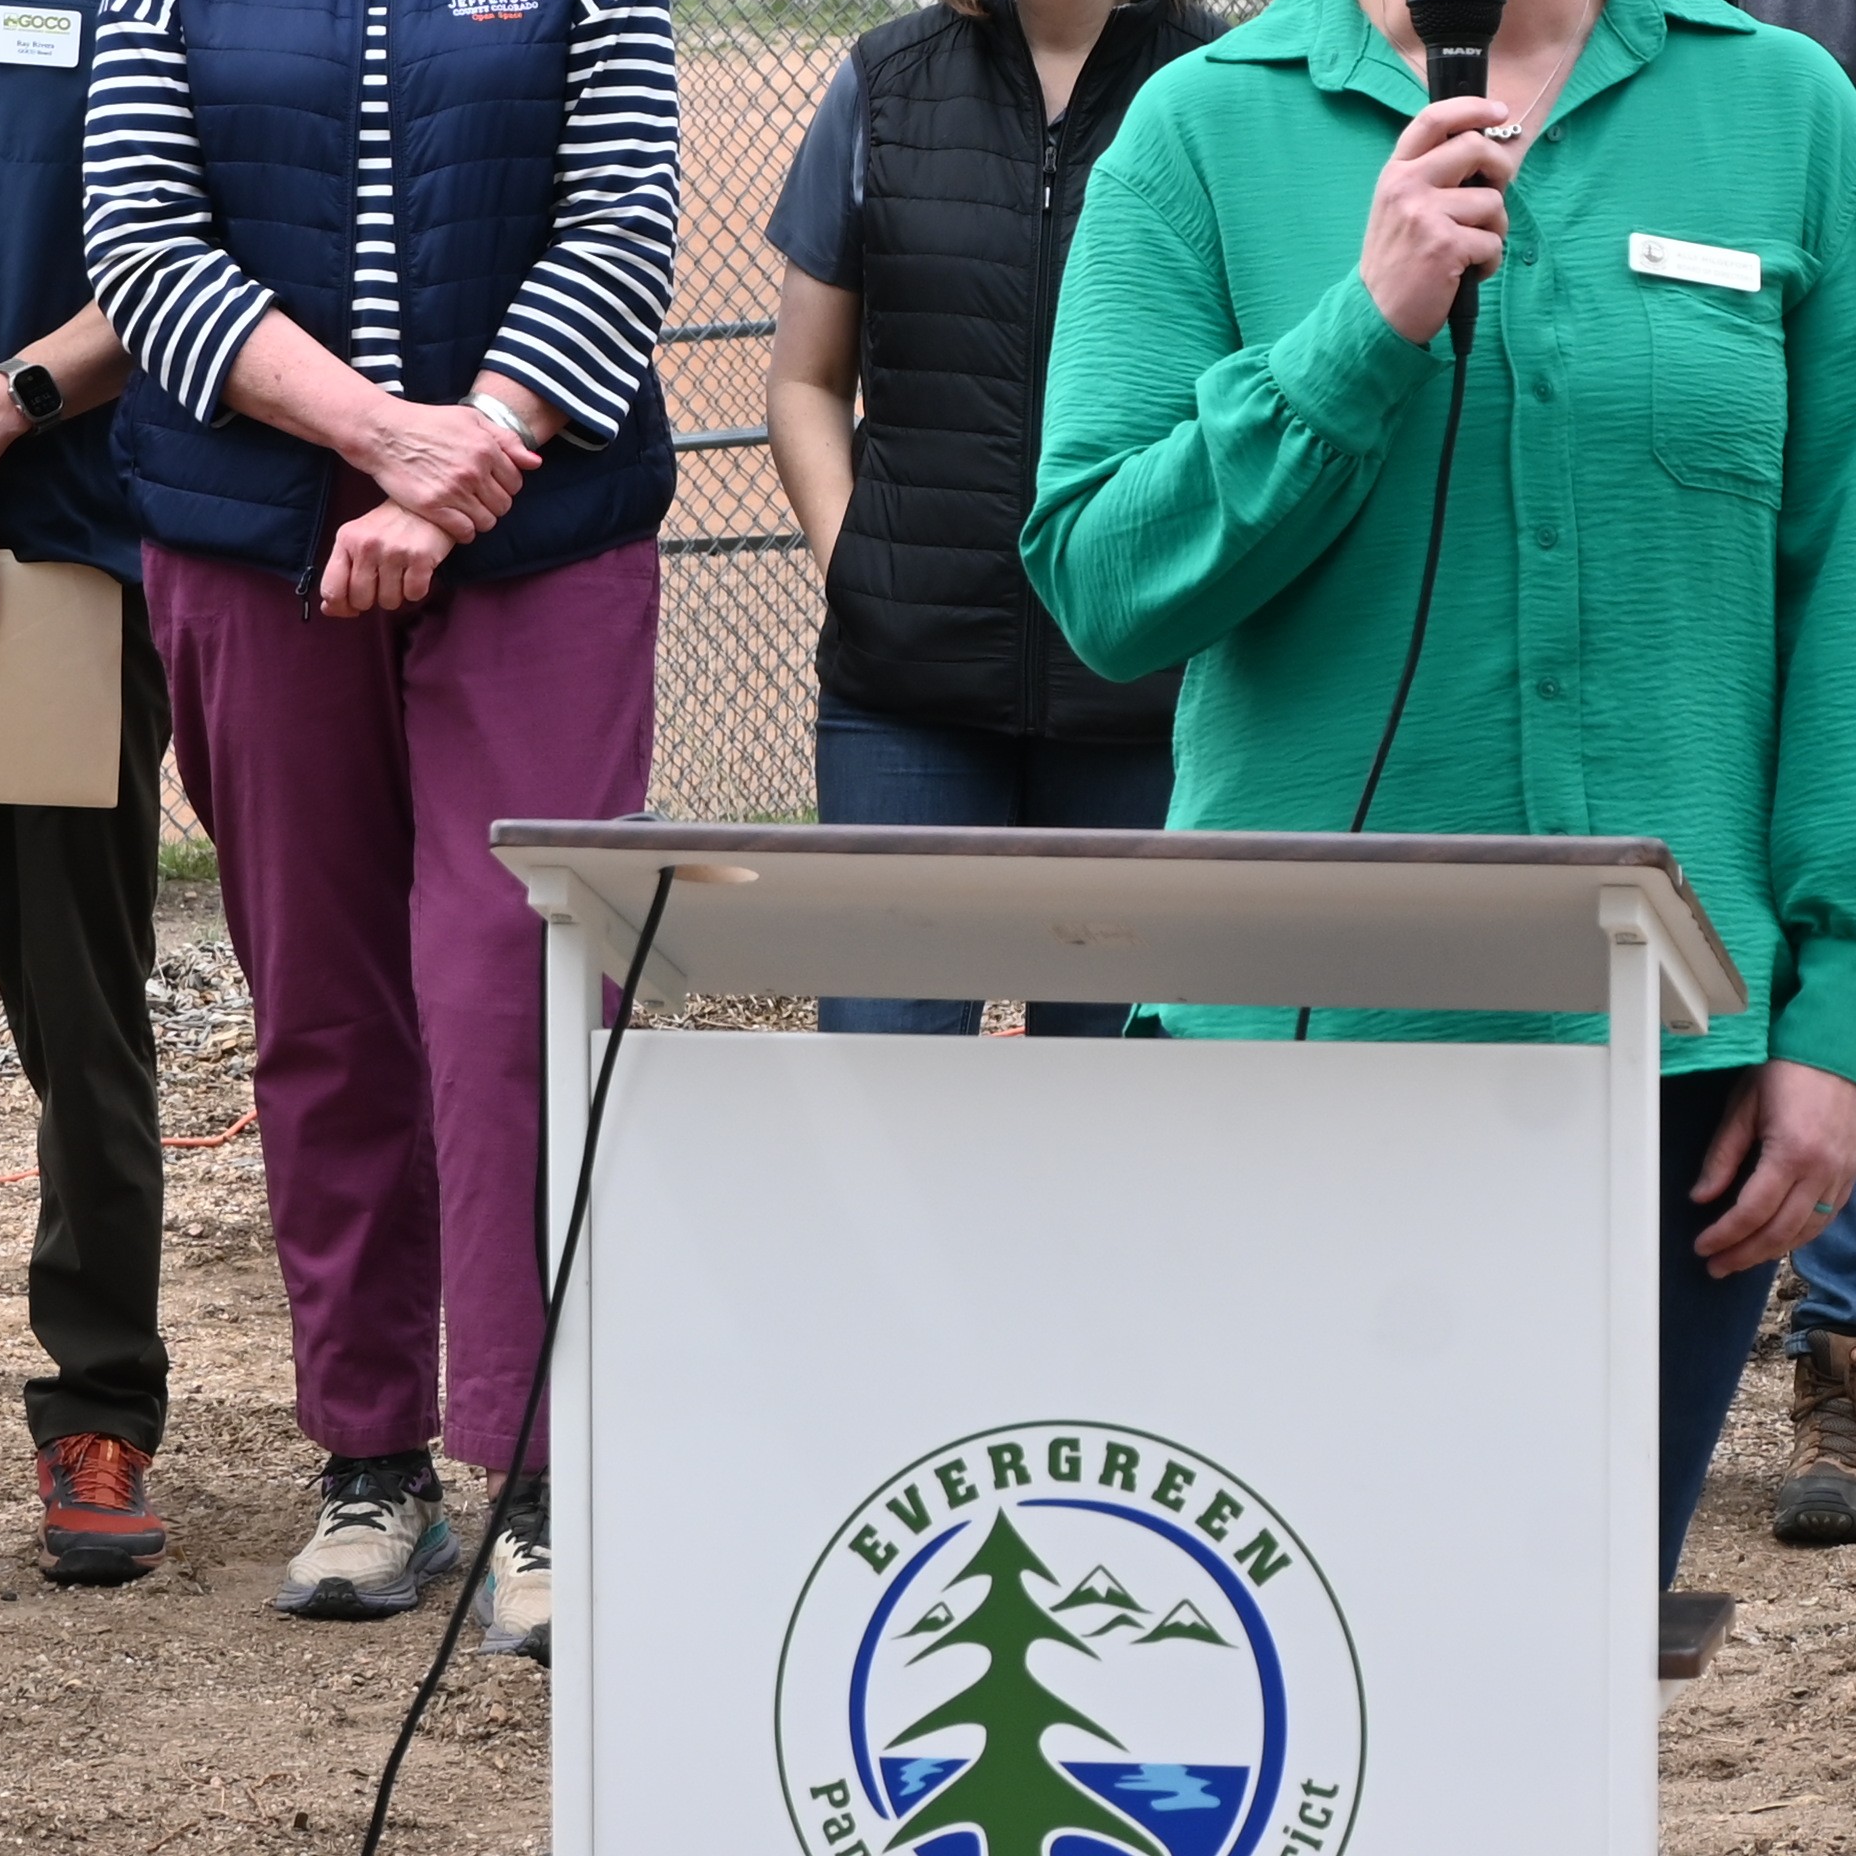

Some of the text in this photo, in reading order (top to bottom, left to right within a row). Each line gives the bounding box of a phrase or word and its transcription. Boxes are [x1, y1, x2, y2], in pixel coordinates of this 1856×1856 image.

[453, 1, 539, 16] COUNTY COLORADO
[19, 14, 71, 31] GOCO
[1443, 47, 1482, 55] NADY
[848, 1437, 1294, 1589] EVERGREEN
